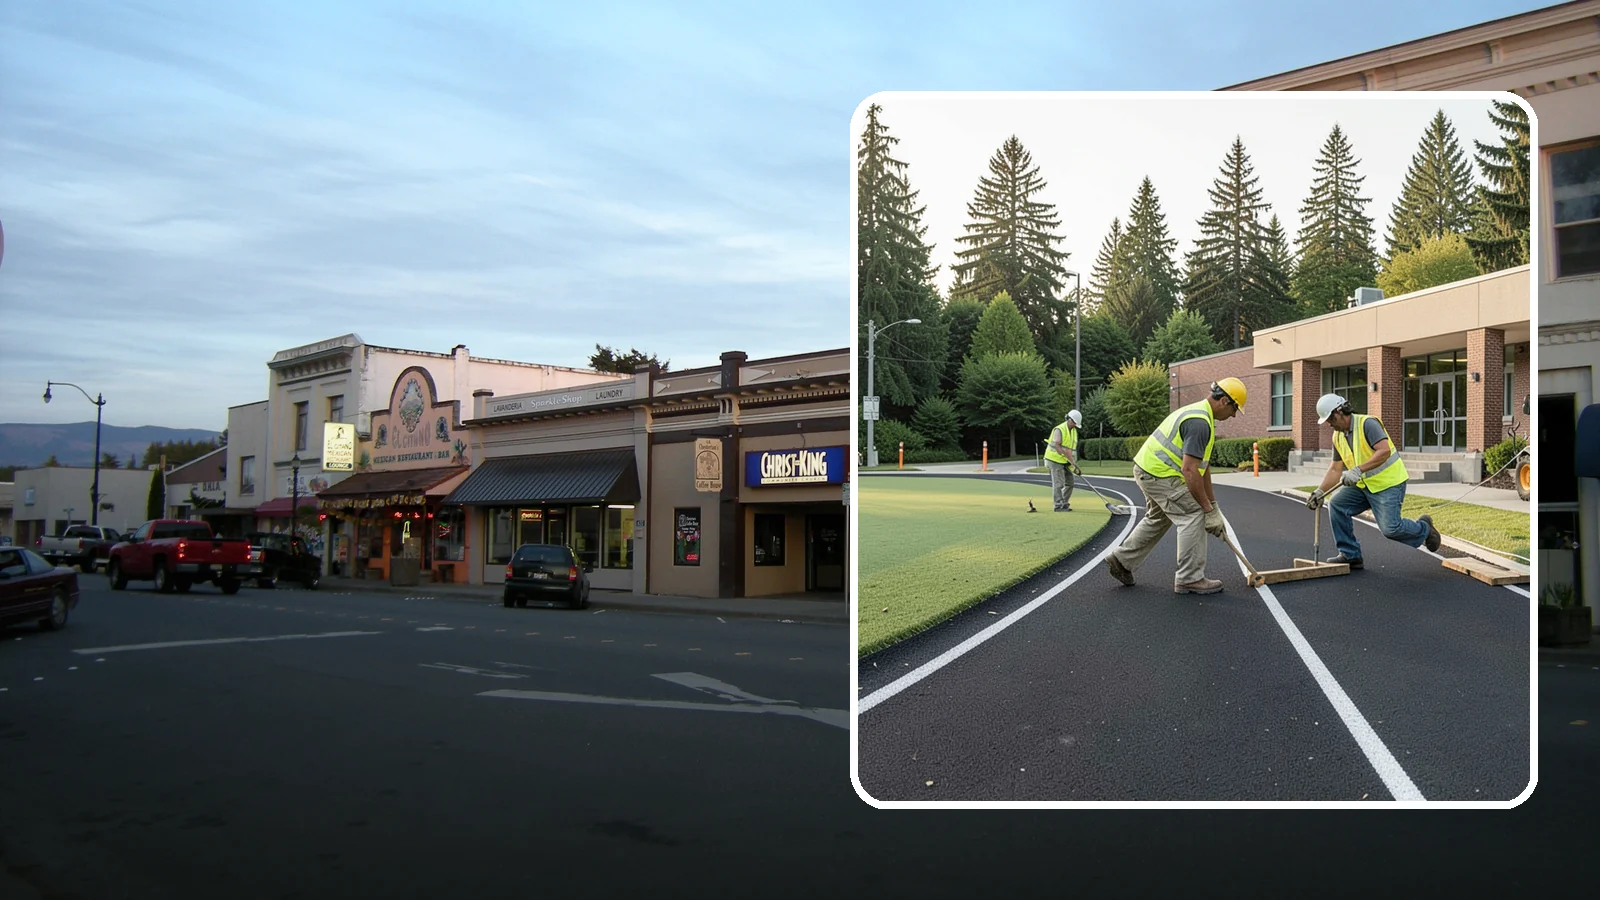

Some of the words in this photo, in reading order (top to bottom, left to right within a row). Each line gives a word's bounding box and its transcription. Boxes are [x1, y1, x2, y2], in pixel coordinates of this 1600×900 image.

[595, 388, 624, 400] LAUNDRY
[561, 395, 583, 406] Shop
[493, 402, 522, 413] LAVANDERIA
[397, 451, 433, 463] RESTAURANT
[438, 450, 450, 459] BAR
[760, 451, 798, 478] CHRIST
[799, 450, 827, 476] KING
